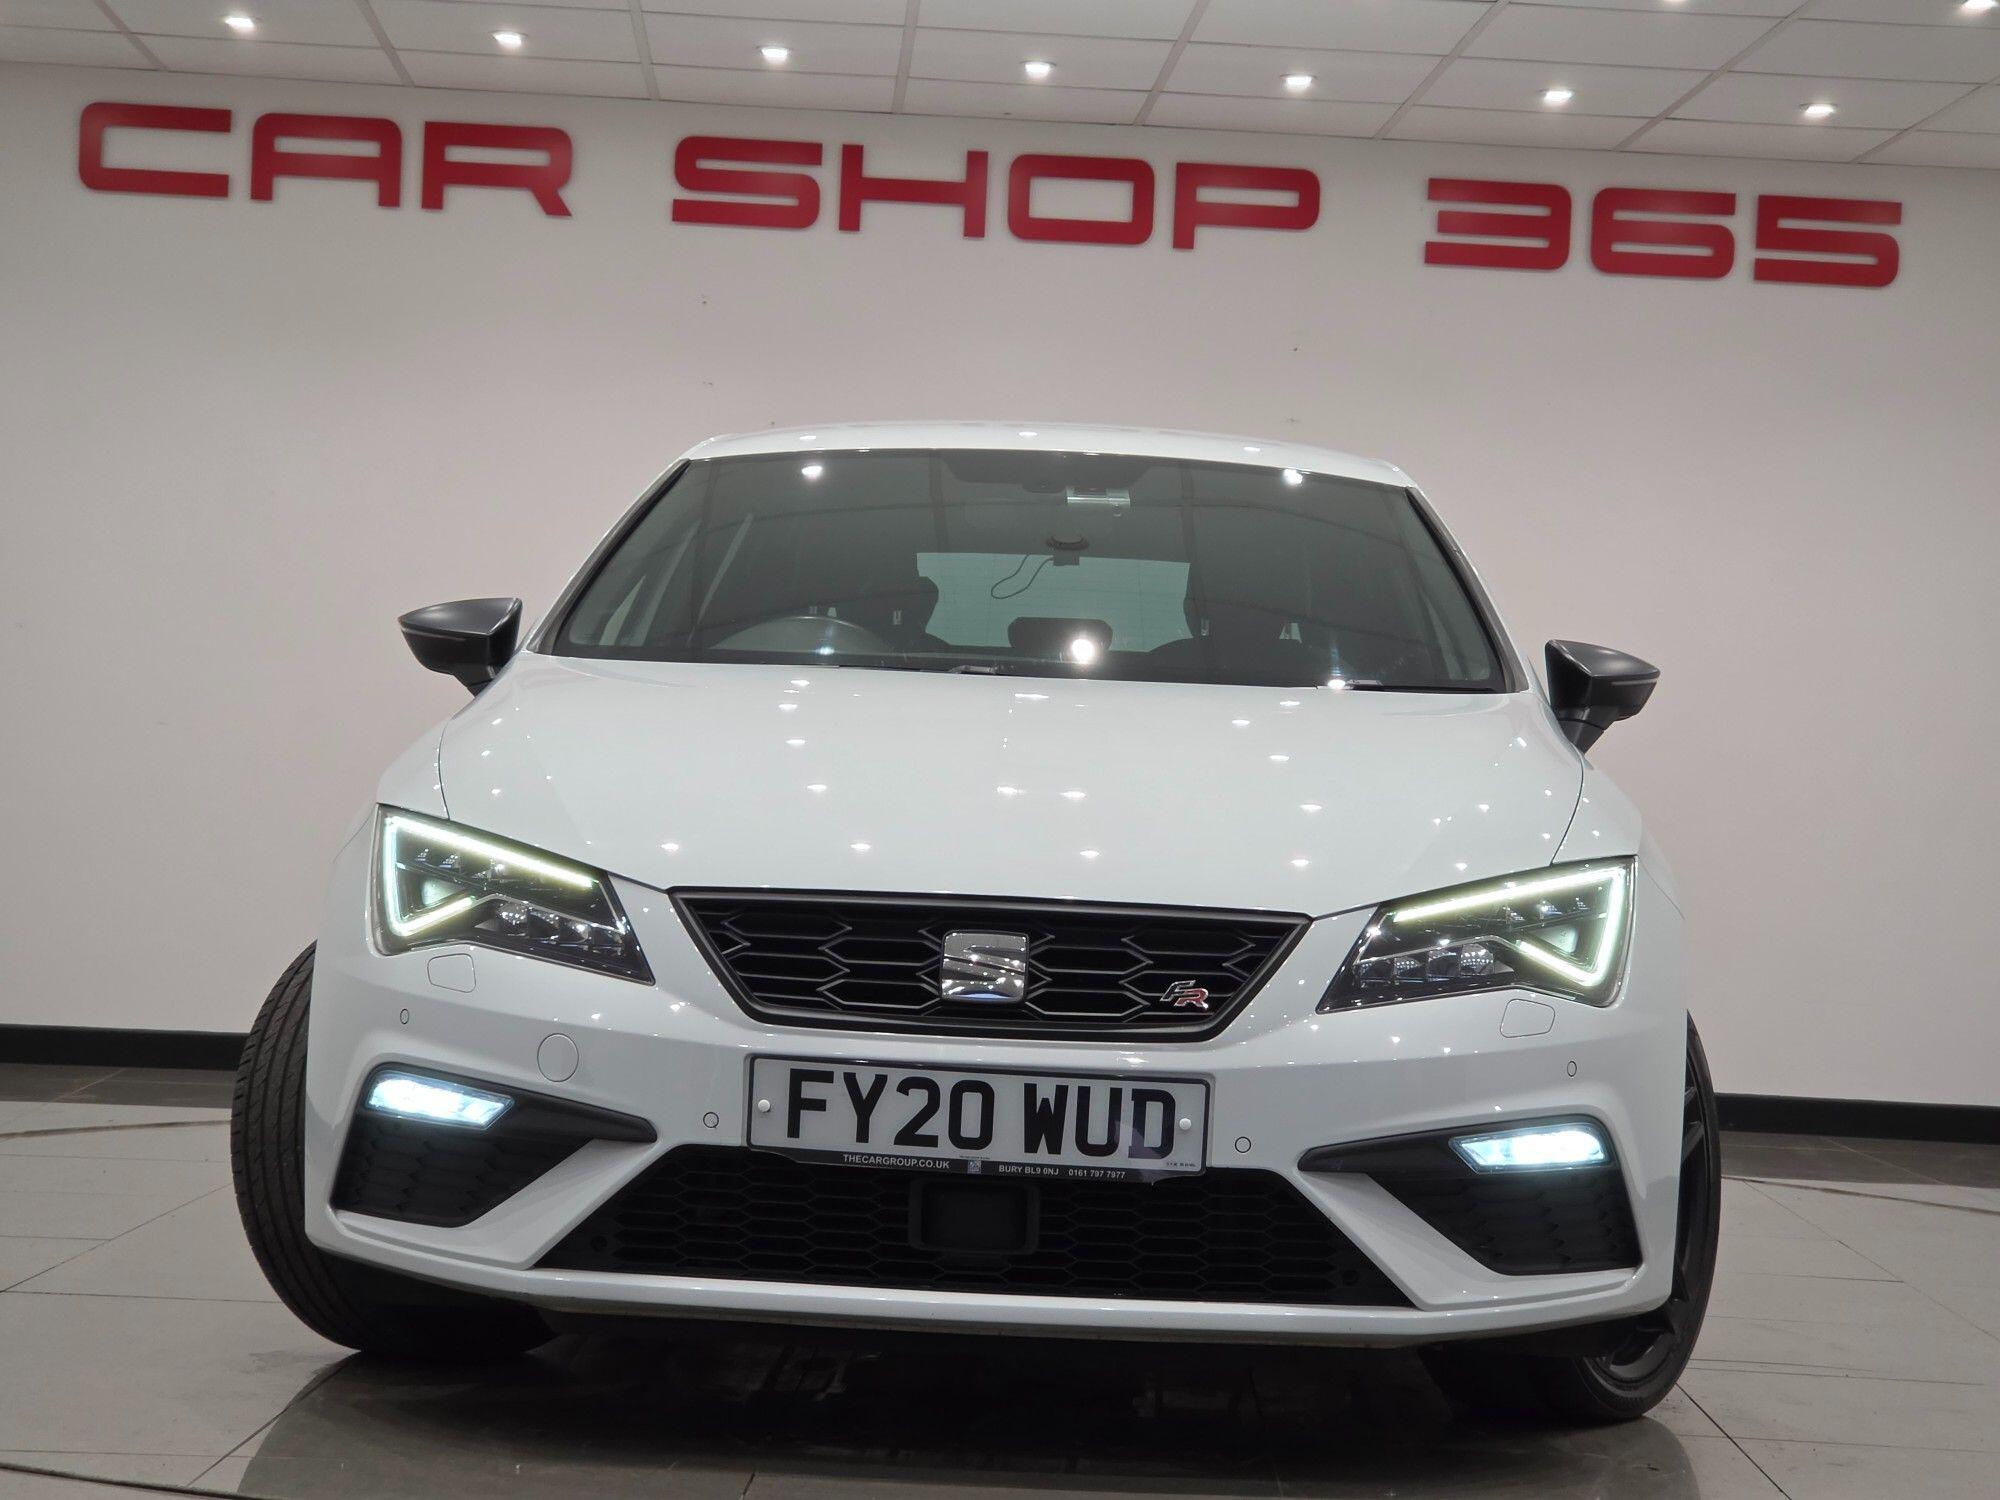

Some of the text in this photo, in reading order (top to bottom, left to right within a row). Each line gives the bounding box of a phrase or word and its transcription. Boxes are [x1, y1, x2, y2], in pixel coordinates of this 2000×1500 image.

[79, 102, 1901, 287] CAR SHOP 365
[1160, 979, 1209, 1009] FR
[786, 1067, 1177, 1160] FY20 WUD
[842, 1153, 950, 1170] THECARGROUP.CO.UK
[998, 1164, 1023, 1174] BURY
[1025, 1166, 1041, 1175] BL9
[1068, 1168, 1088, 1177] 0161
[1090, 1169, 1104, 1178] 797
[1106, 1170, 1126, 1179] 7977
